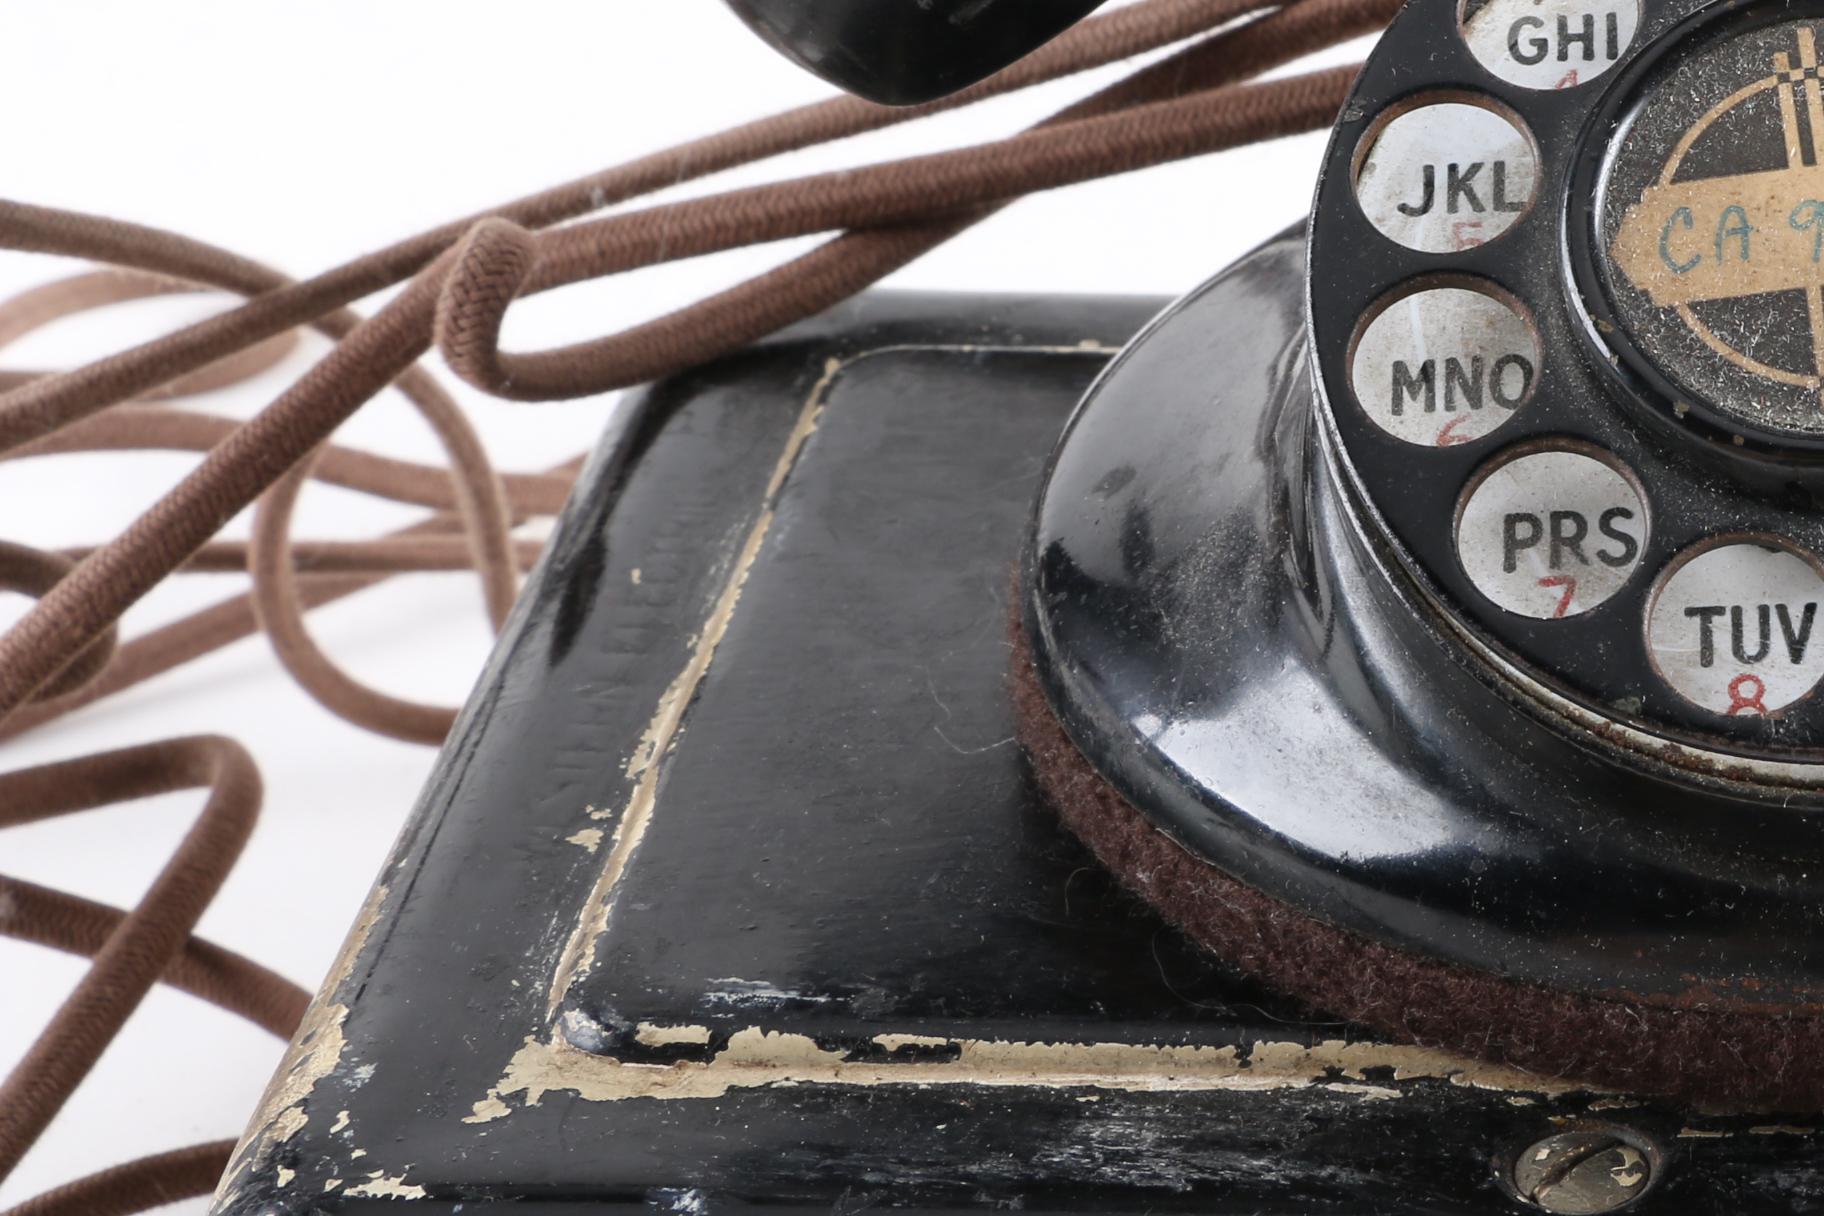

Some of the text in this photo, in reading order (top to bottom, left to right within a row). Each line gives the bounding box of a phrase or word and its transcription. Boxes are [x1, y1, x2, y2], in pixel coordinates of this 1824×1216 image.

[1507, 11, 1618, 66] GHI
[1397, 160, 1528, 217] JKL
[1658, 205, 1758, 275] CA
[1391, 353, 1534, 416] MNO
[1502, 506, 1638, 574] PRS
[1537, 575, 1577, 619] 7
[1684, 602, 1818, 668] TUV
[1727, 673, 1767, 716] 8
